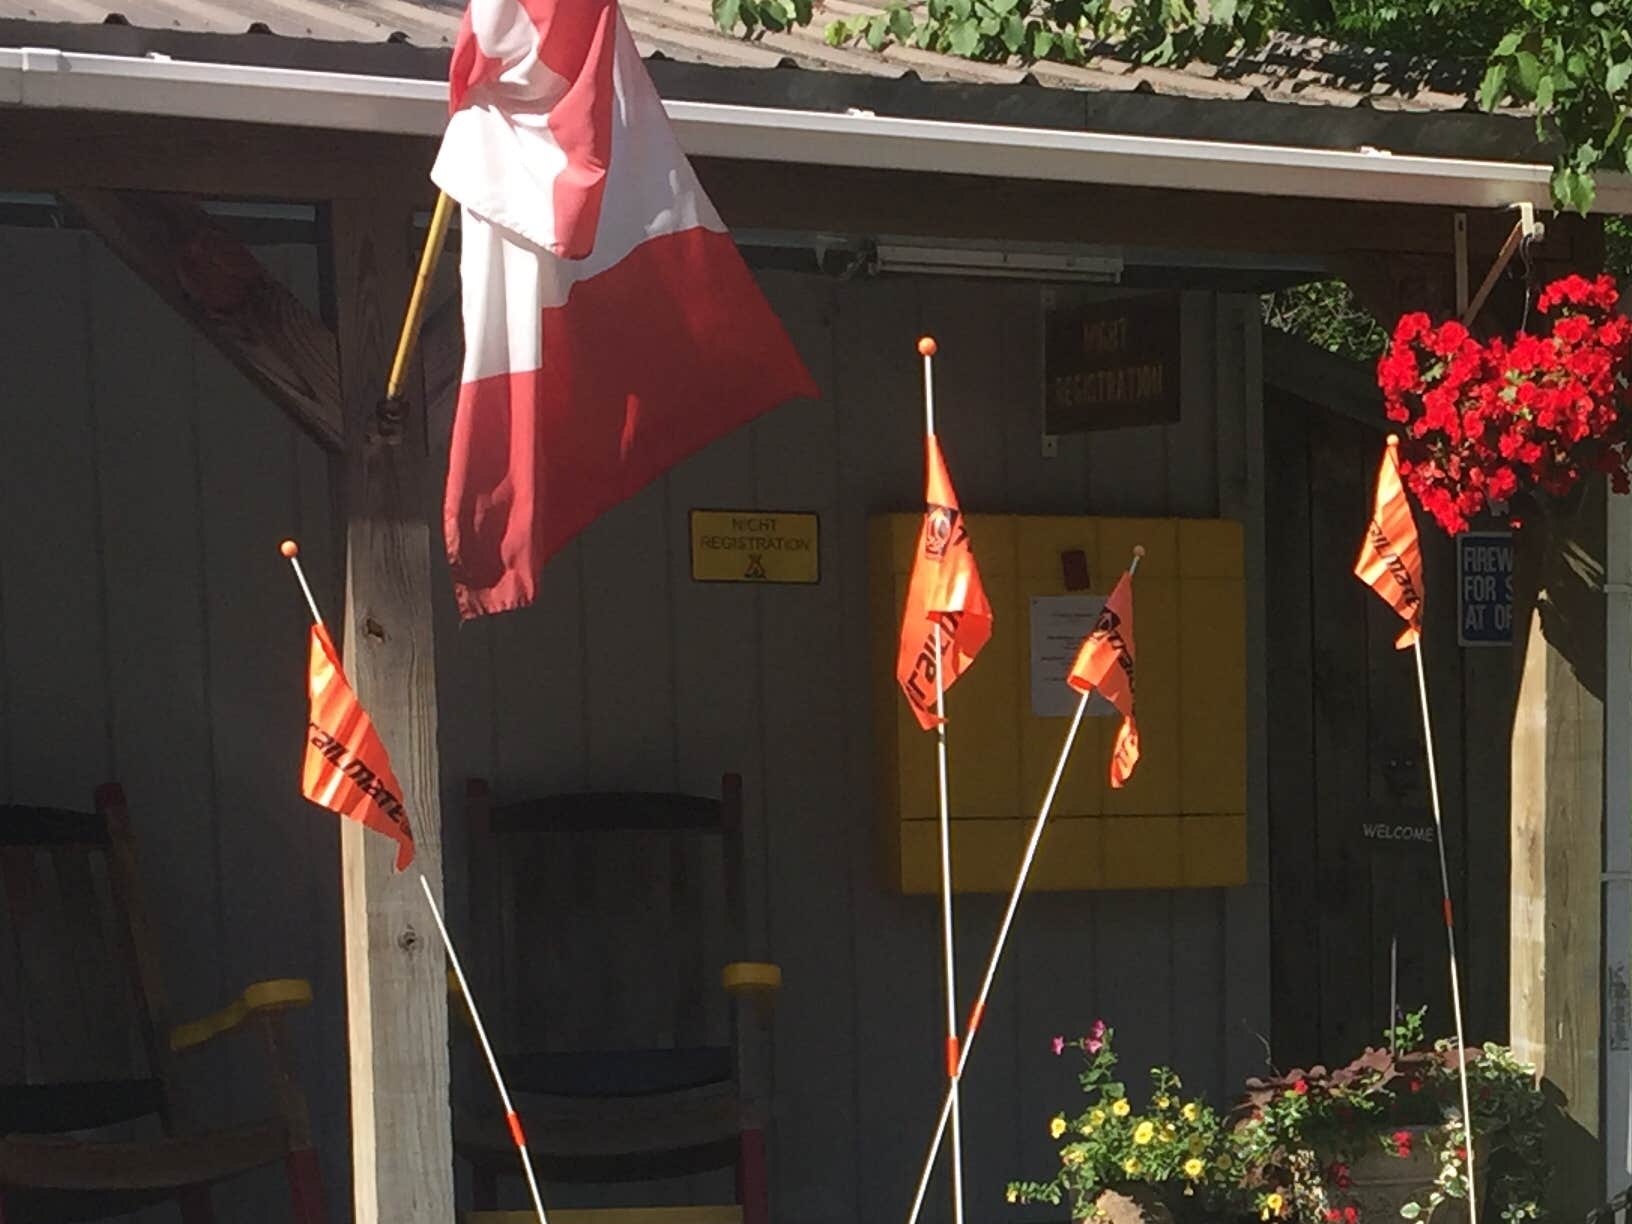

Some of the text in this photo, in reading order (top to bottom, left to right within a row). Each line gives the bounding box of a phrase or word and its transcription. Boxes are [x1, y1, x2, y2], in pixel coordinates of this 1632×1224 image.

[1463, 575, 1497, 602] FOR
[1464, 603, 1488, 631] AT
[1362, 823, 1434, 842] WELCOME
